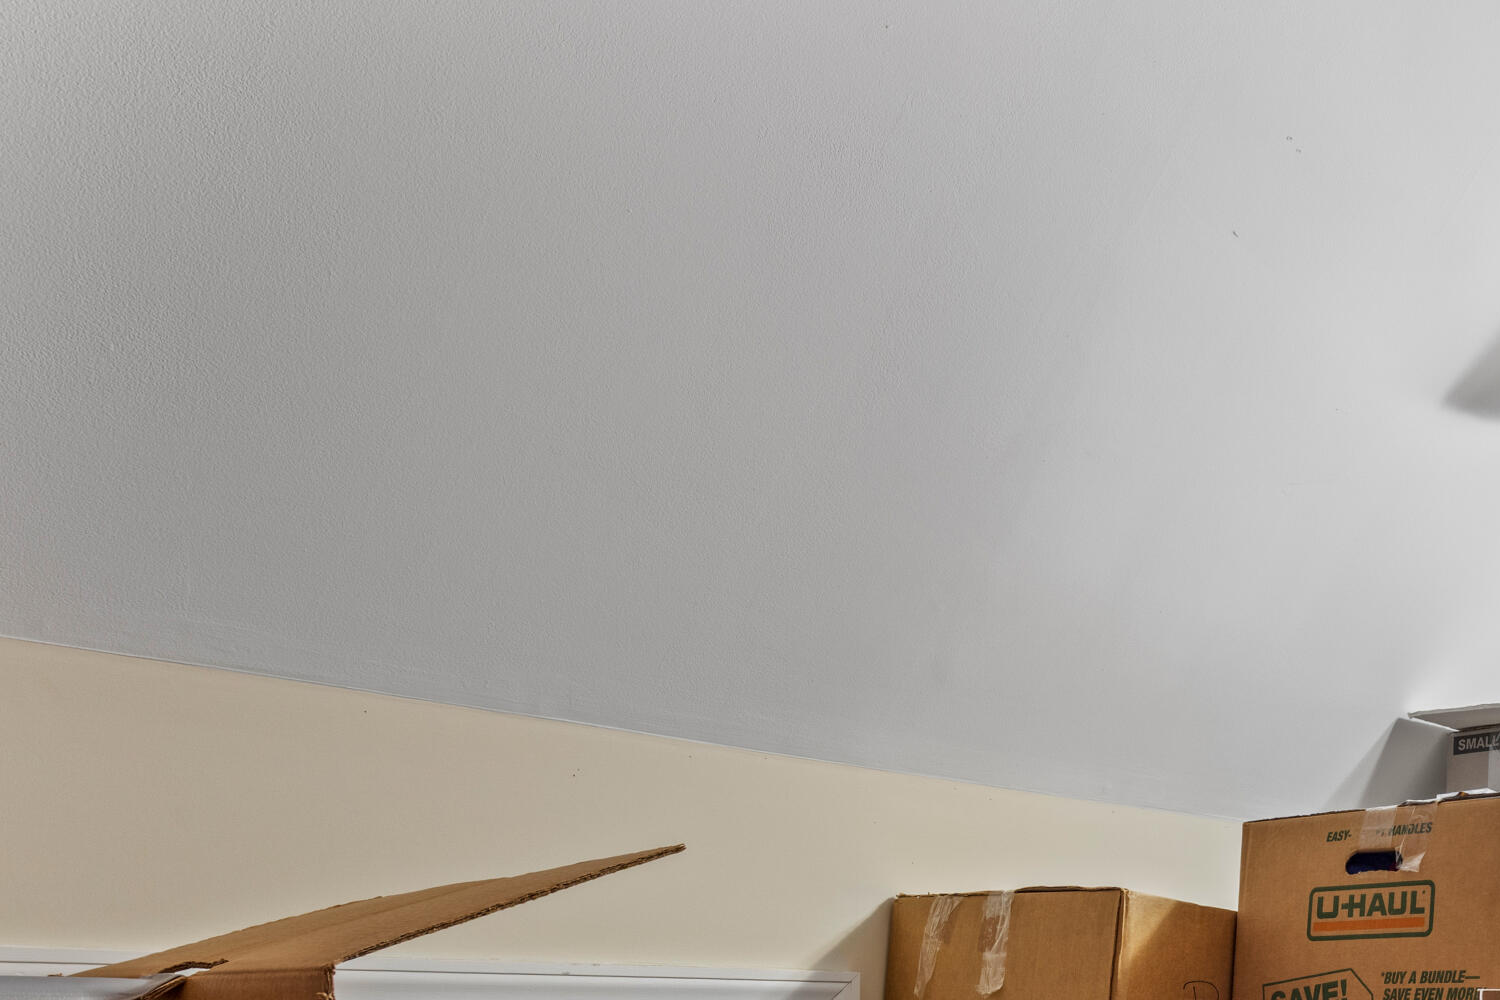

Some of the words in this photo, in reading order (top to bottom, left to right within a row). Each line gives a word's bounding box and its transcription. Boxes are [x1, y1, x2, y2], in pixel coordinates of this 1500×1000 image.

[1458, 735, 1500, 750] SMALL
[1391, 822, 1433, 837] HANDLES
[1408, 971, 1417, 984] A
[1383, 988, 1411, 1000] SAVE
[1413, 988, 1444, 1000] EVEN
